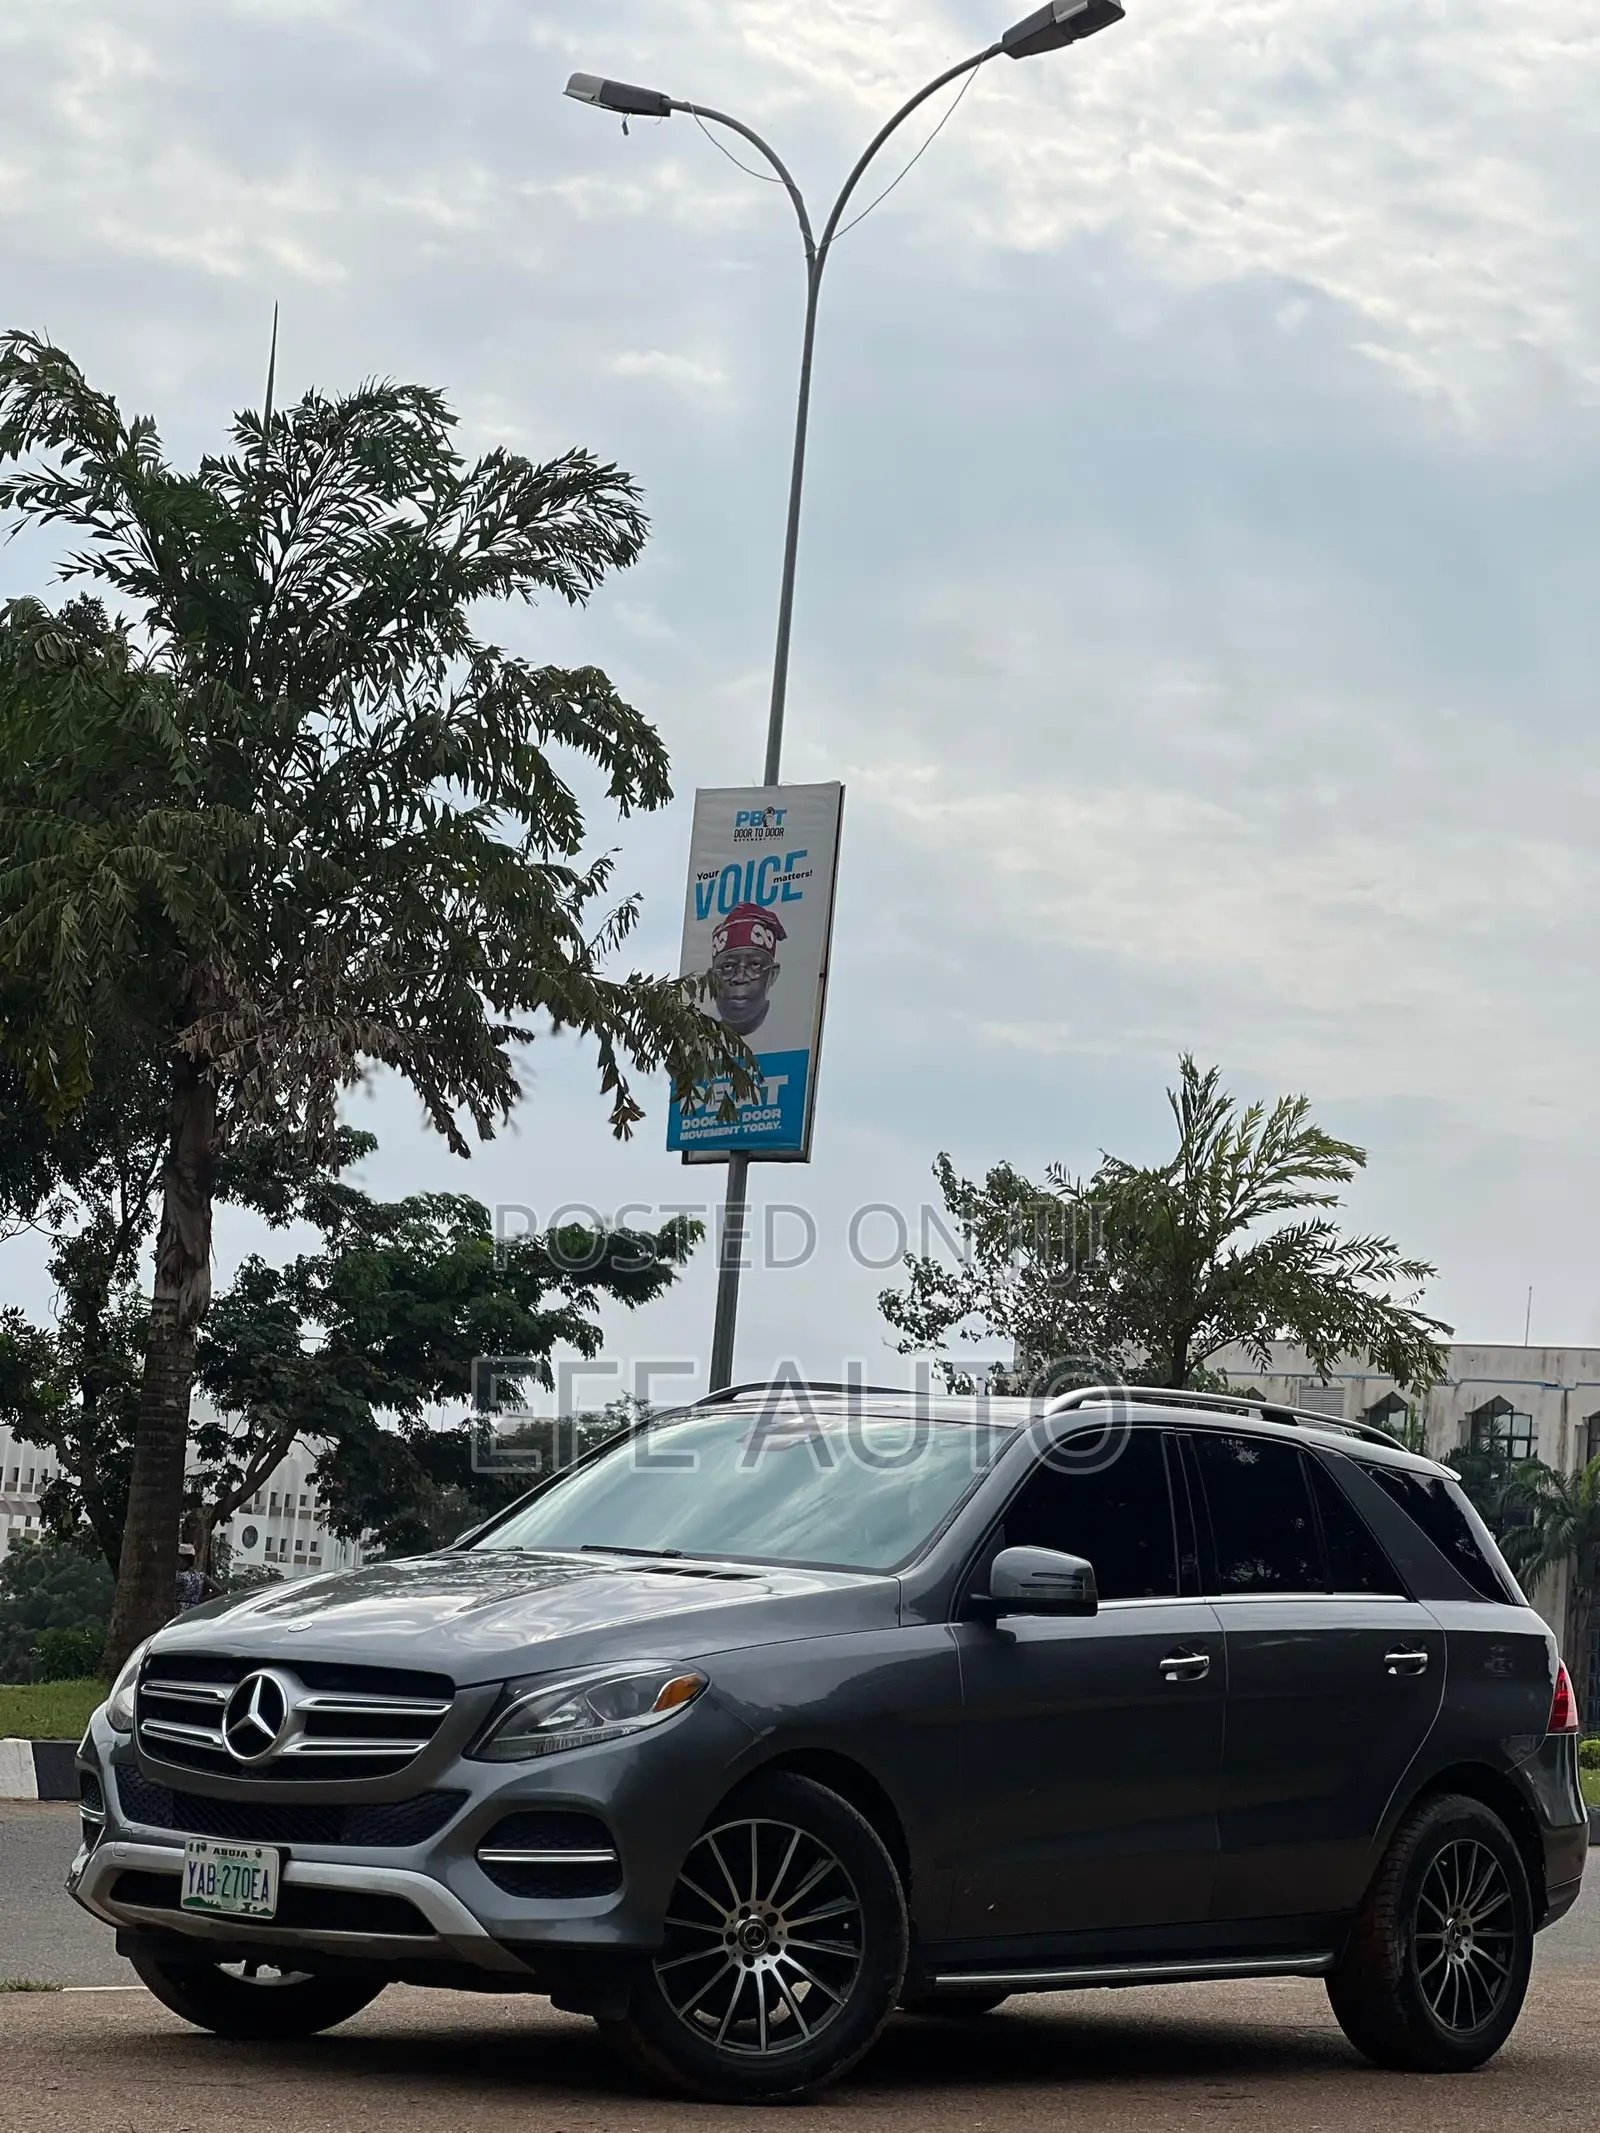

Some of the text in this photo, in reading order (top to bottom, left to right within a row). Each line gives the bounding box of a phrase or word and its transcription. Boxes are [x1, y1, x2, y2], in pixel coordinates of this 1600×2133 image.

[734, 827, 785, 838] DOOR TO DOOR
[697, 870, 719, 881] Your
[773, 869, 813, 884] matters!
[695, 850, 808, 921] VOICE
[682, 1117, 719, 1129] DOOR
[742, 1109, 781, 1122] DOOR
[680, 1121, 781, 1140] MOVEMENT TODAY.
[213, 1847, 249, 1859] ABUJA
